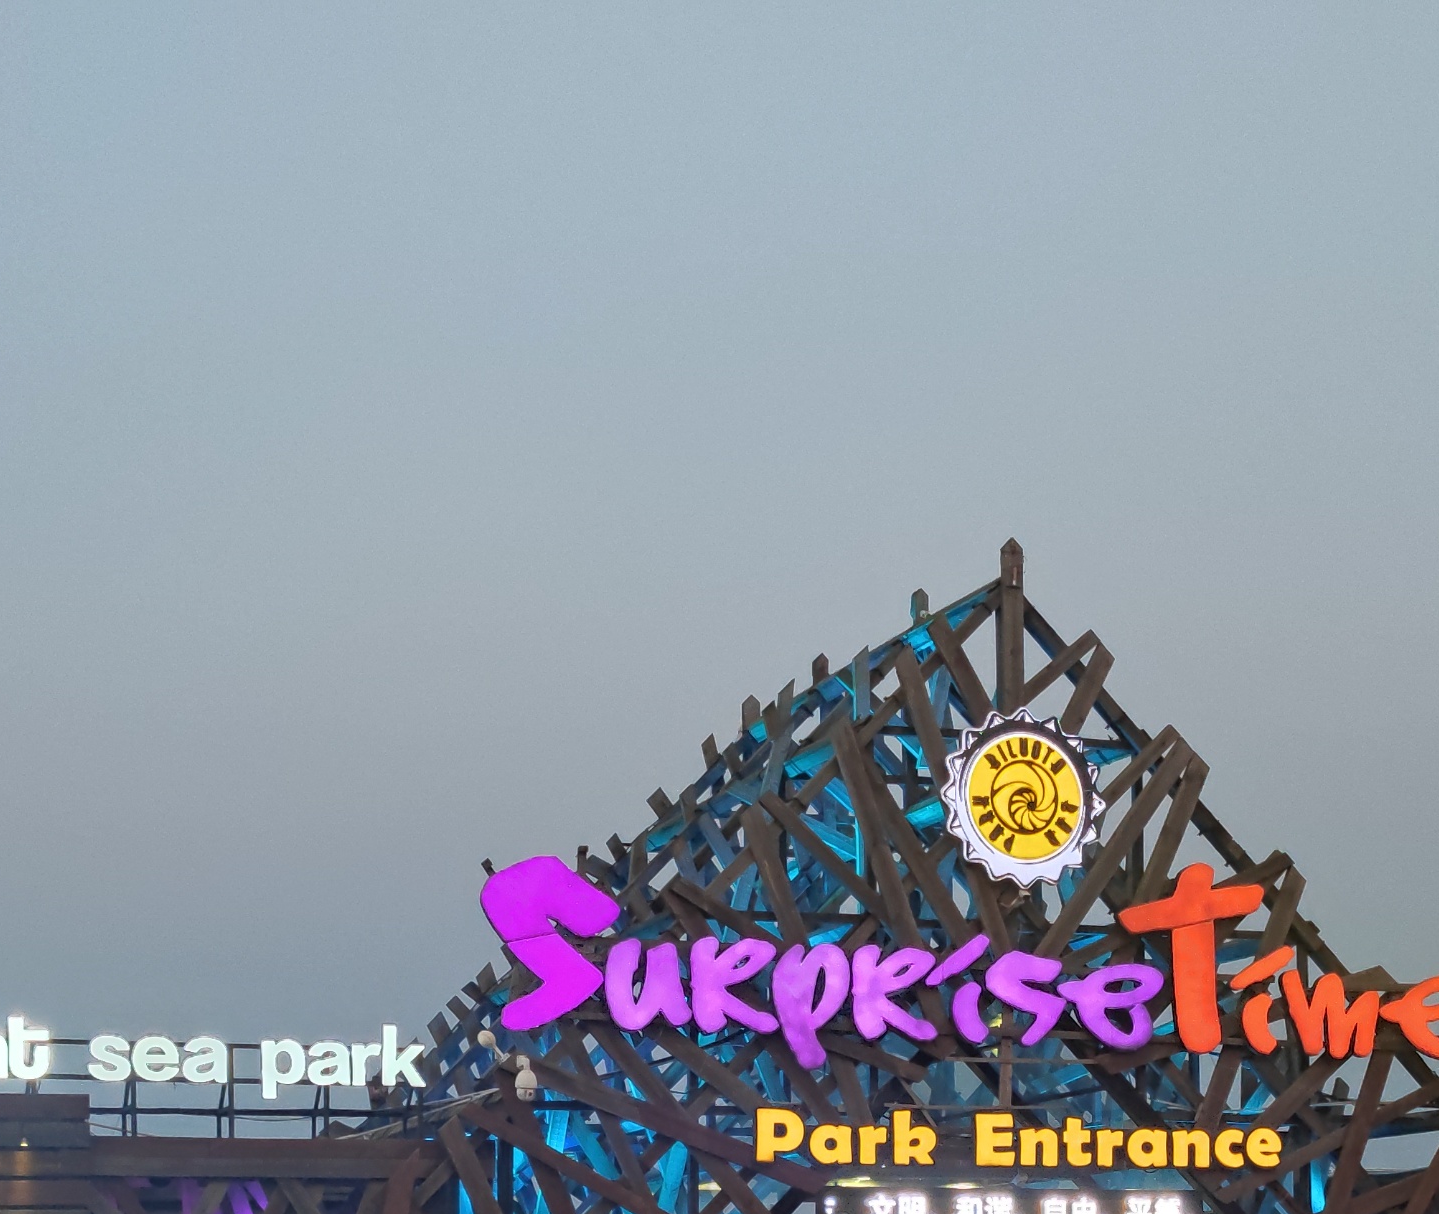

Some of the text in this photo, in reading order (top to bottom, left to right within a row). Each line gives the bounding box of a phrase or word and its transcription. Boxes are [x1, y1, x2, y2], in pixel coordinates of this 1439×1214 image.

[984, 737, 1067, 776] BILUOTA
[480, 854, 1165, 1070] Surprise
[89, 1033, 229, 1084] sea
[261, 1023, 425, 1100] park
[755, 1107, 1284, 1170] Park Entrance
